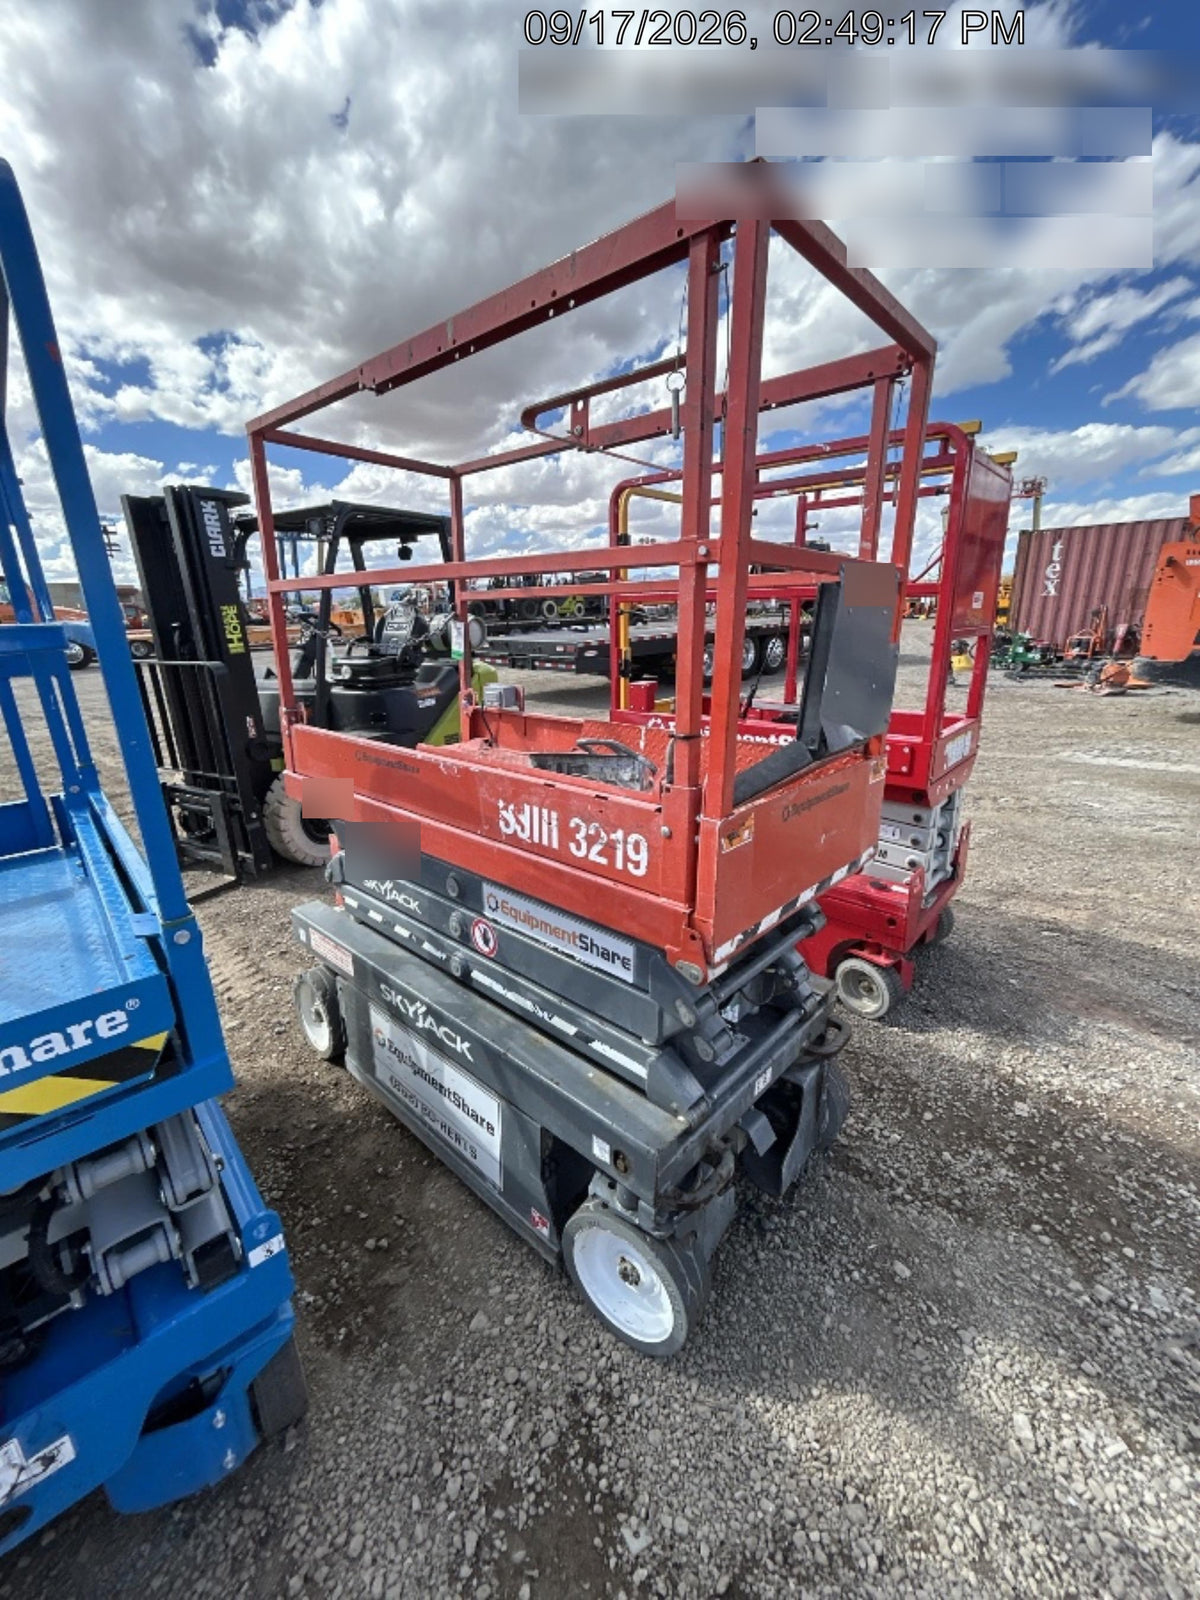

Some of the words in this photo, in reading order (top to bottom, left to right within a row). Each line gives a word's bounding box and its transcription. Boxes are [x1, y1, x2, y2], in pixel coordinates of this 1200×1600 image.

[200, 500, 226, 558] CLARK
[568, 806, 648, 877] 3219
[500, 899, 631, 972] EquipmentShare
[379, 983, 475, 1063] SKYJACK
